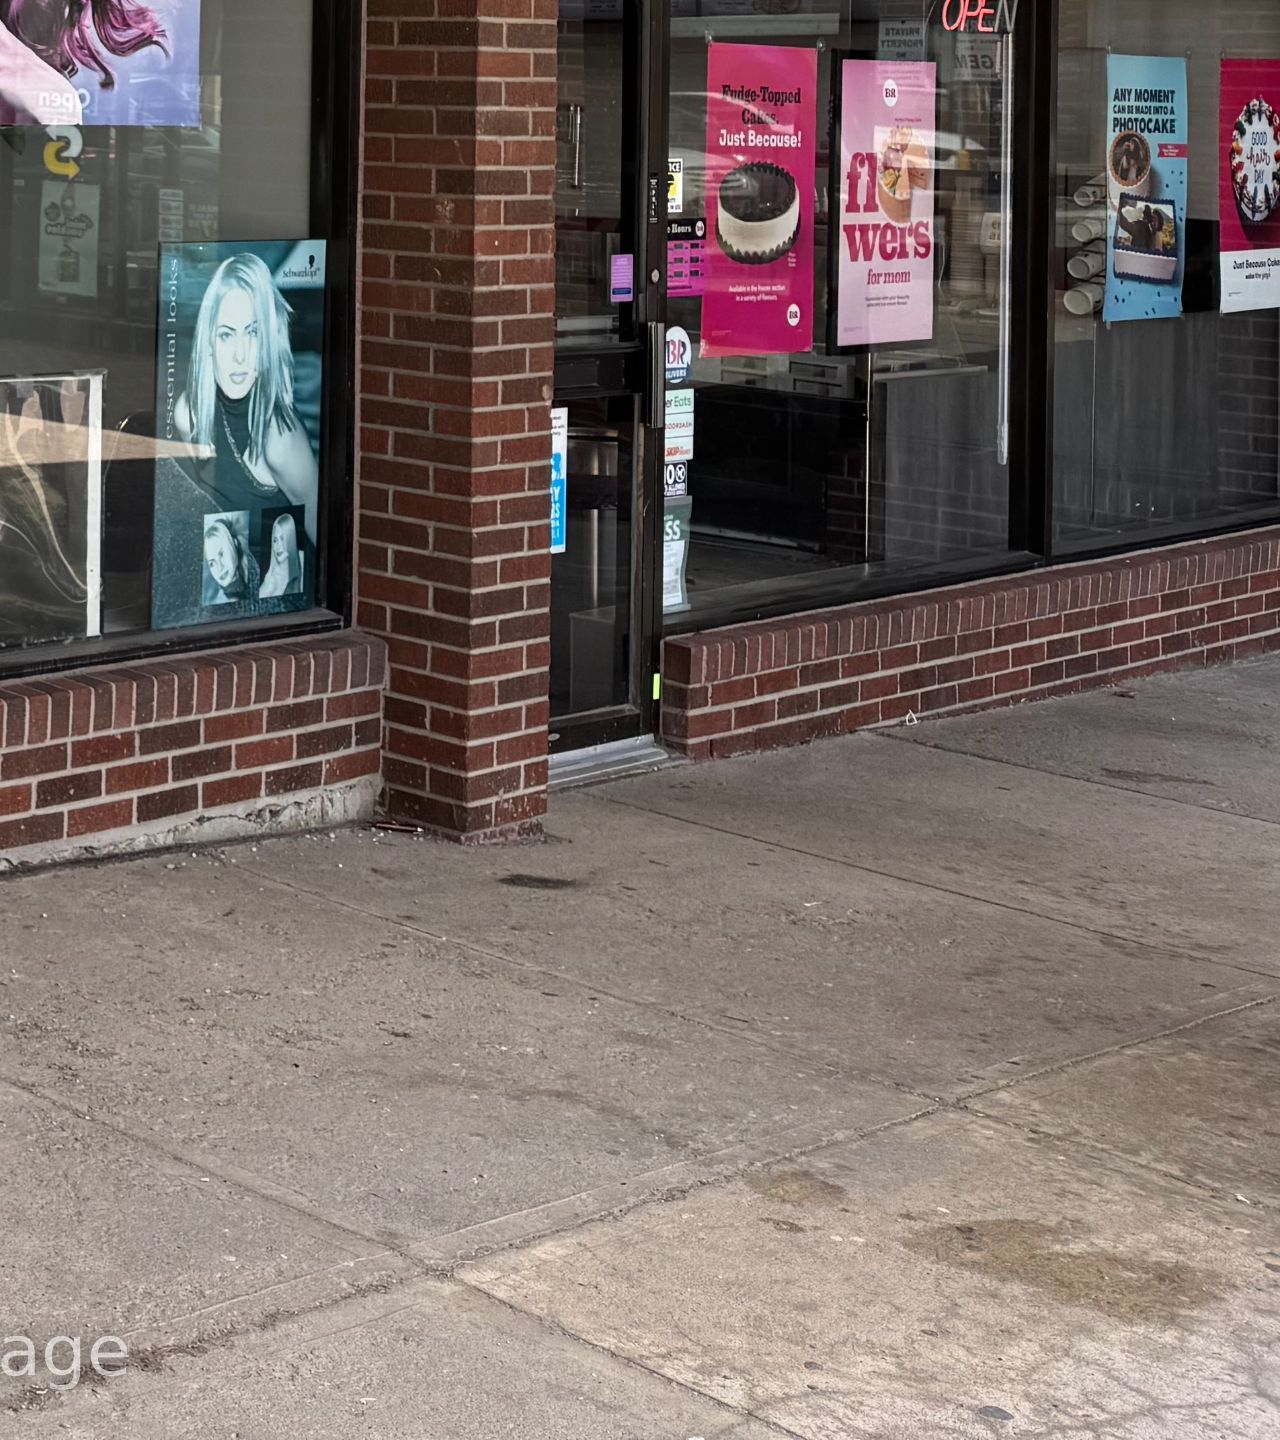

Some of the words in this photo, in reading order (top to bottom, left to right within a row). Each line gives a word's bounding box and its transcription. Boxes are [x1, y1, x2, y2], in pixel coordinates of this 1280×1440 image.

[721, 85, 801, 106] Fudge-Topped
[1113, 88, 1132, 102] ANY
[1135, 89, 1175, 103] MOMENT
[1113, 105, 1126, 114] CAN
[1127, 105, 1134, 114] BE
[1135, 105, 1152, 115] MADE
[1153, 106, 1168, 115] INTO
[1170, 106, 1175, 115] A
[1113, 117, 1176, 133] PHOTOCAKE
[719, 129, 745, 146] Just
[748, 130, 802, 147] Because!
[1251, 132, 1268, 146] GOOD
[1246, 147, 1271, 168] hair
[1254, 169, 1264, 184] DAY
[1233, 260, 1245, 270] Just
[867, 269, 882, 285] for
[884, 271, 911, 284] mom
[166, 258, 178, 322] looks
[166, 333, 176, 439] essential
[674, 396, 692, 407] Eats
